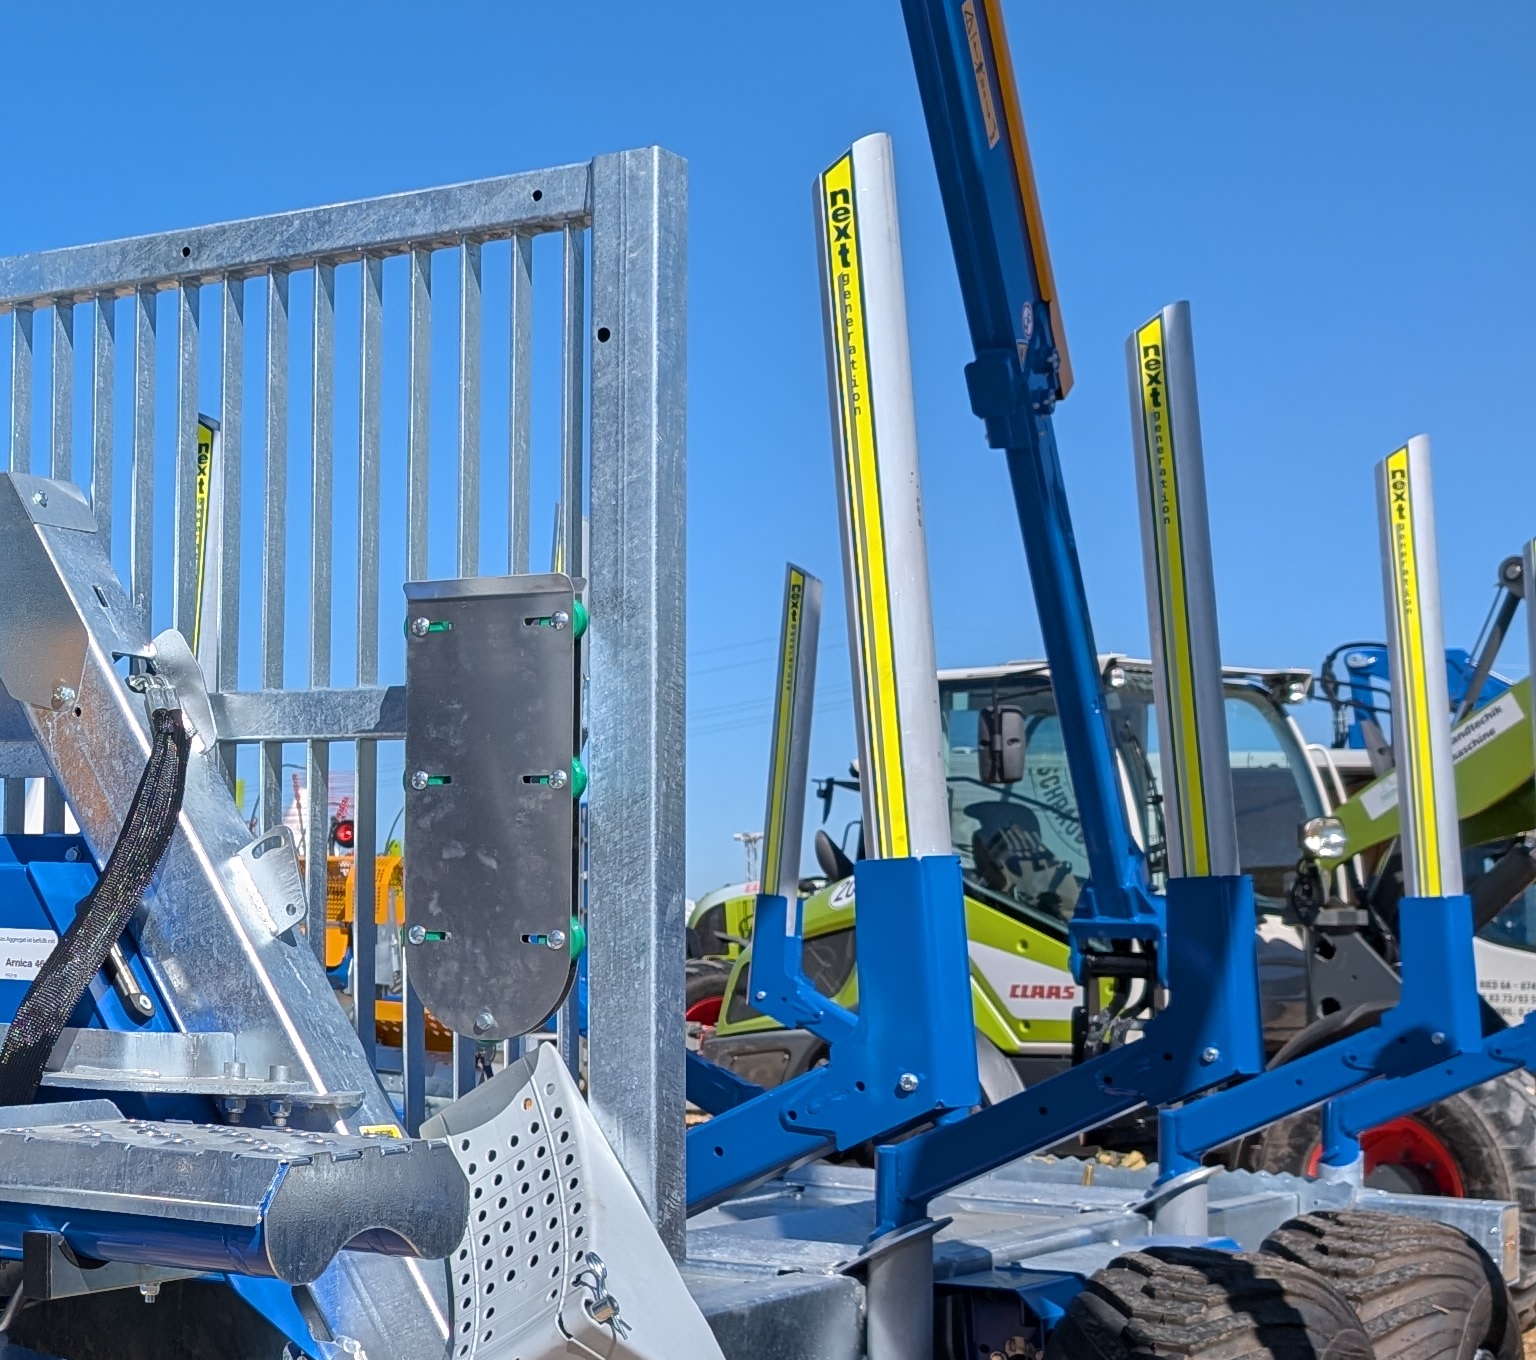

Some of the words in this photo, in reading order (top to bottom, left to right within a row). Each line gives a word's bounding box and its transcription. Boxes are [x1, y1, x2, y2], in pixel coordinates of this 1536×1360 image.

[830, 187, 852, 269] next
[841, 272, 862, 417] generation
[1142, 344, 1162, 408] next
[197, 442, 210, 495] next
[1390, 469, 1406, 520] next
[5, 957, 33, 968] Arnica
[1009, 983, 1075, 1000] CLAAS
